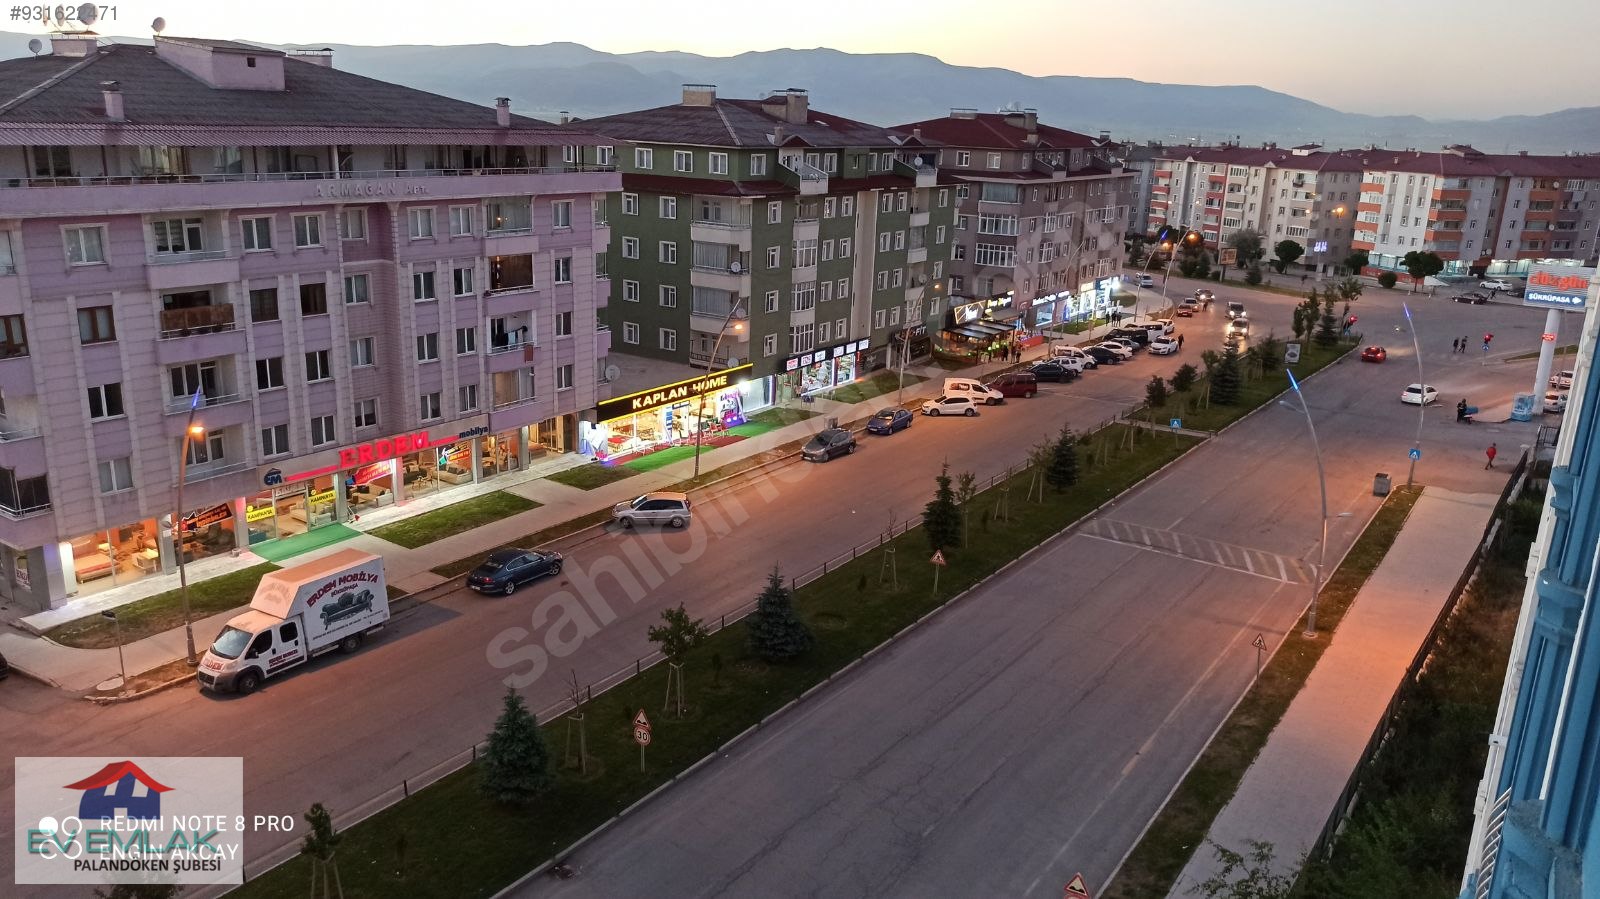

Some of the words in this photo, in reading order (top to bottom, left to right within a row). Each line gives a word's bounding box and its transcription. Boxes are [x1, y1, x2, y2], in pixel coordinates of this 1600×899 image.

[632, 387, 687, 410] KAPLAN
[693, 375, 728, 391] HOME
[338, 431, 430, 469] ERDEM
[459, 425, 489, 439] mobilya
[306, 581, 337, 607] ERDEM
[338, 570, 379, 587] MOBİLYA
[637, 730, 648, 741] 30
